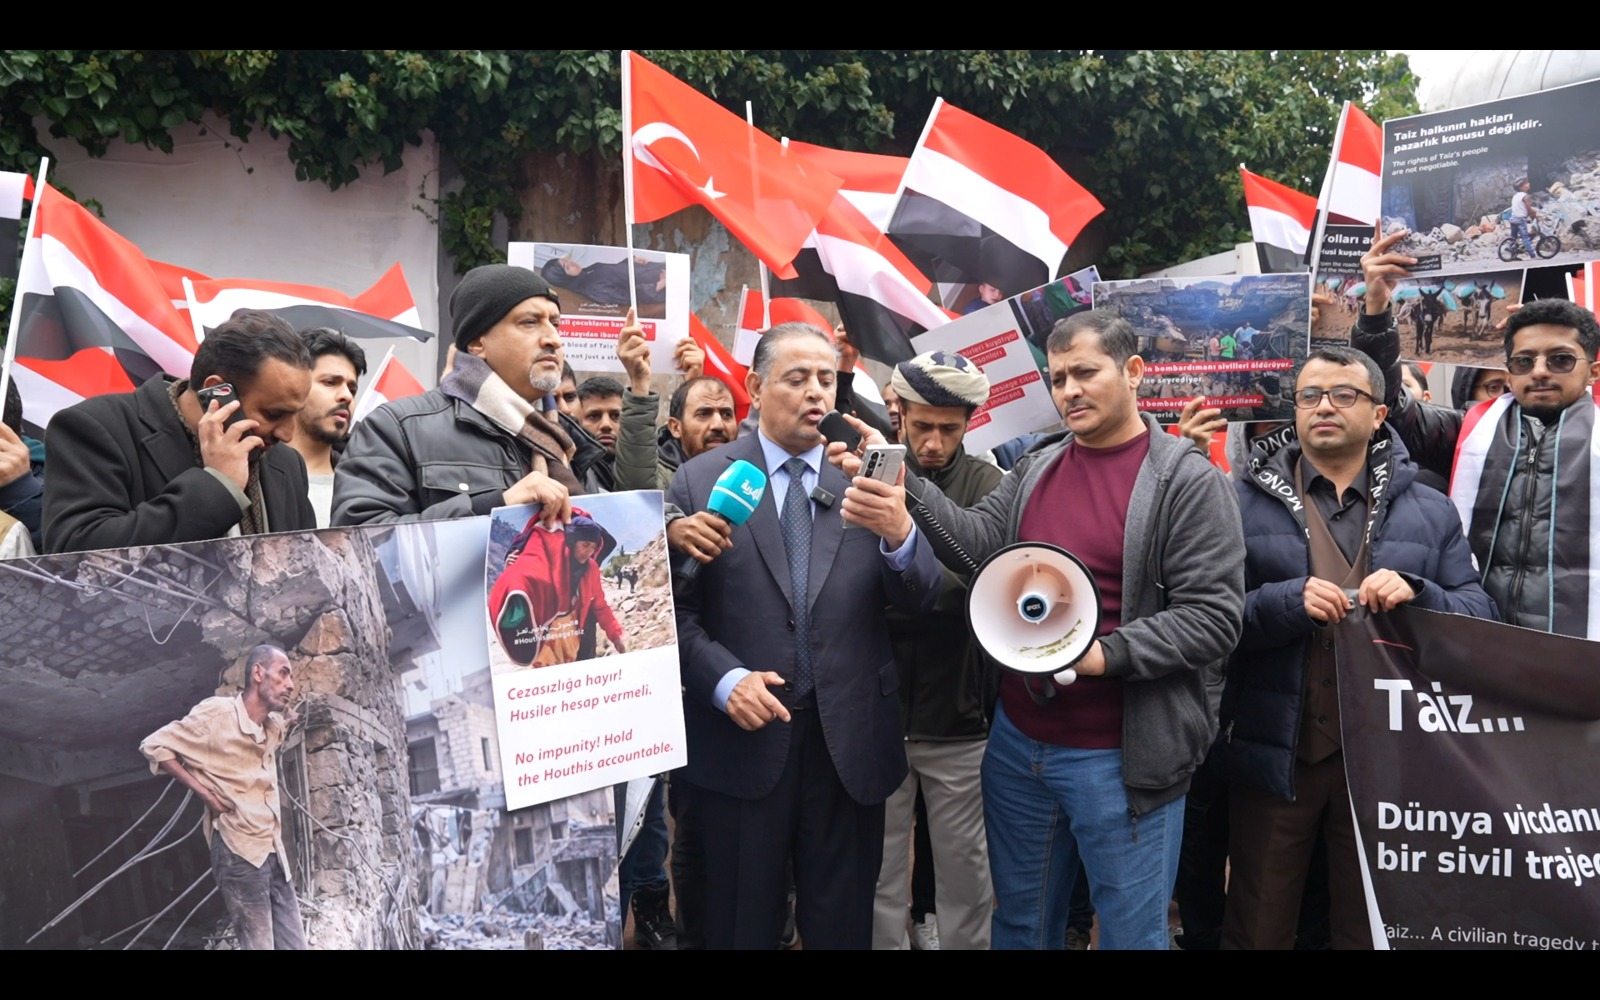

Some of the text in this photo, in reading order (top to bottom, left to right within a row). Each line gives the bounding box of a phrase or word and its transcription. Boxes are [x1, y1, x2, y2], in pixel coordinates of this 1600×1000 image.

[1394, 113, 1513, 141] Taiz halkının hakları
[1394, 119, 1542, 154] pazarlık konusu değildir.
[1392, 161, 1459, 176] are not negotiable.
[1407, 157, 1428, 166] rights
[1440, 151, 1460, 160] Taiz's
[1462, 147, 1488, 157] people
[990, 373, 1039, 394] besiege cities
[507, 669, 622, 700] Cezasızlığa hayır!
[510, 684, 652, 722] Husiler hesap vermeli.
[1374, 678, 1525, 734] Taiz...
[516, 728, 633, 765] No impunity! Hold
[518, 742, 674, 786] the Houthis accountable.
[1377, 802, 1492, 840] Dünya
[1377, 842, 1426, 872] bir
[1438, 846, 1512, 877] sivil
[1383, 924, 1425, 939] aiz...
[1431, 926, 1443, 940] A
[1448, 927, 1507, 944] civilian
